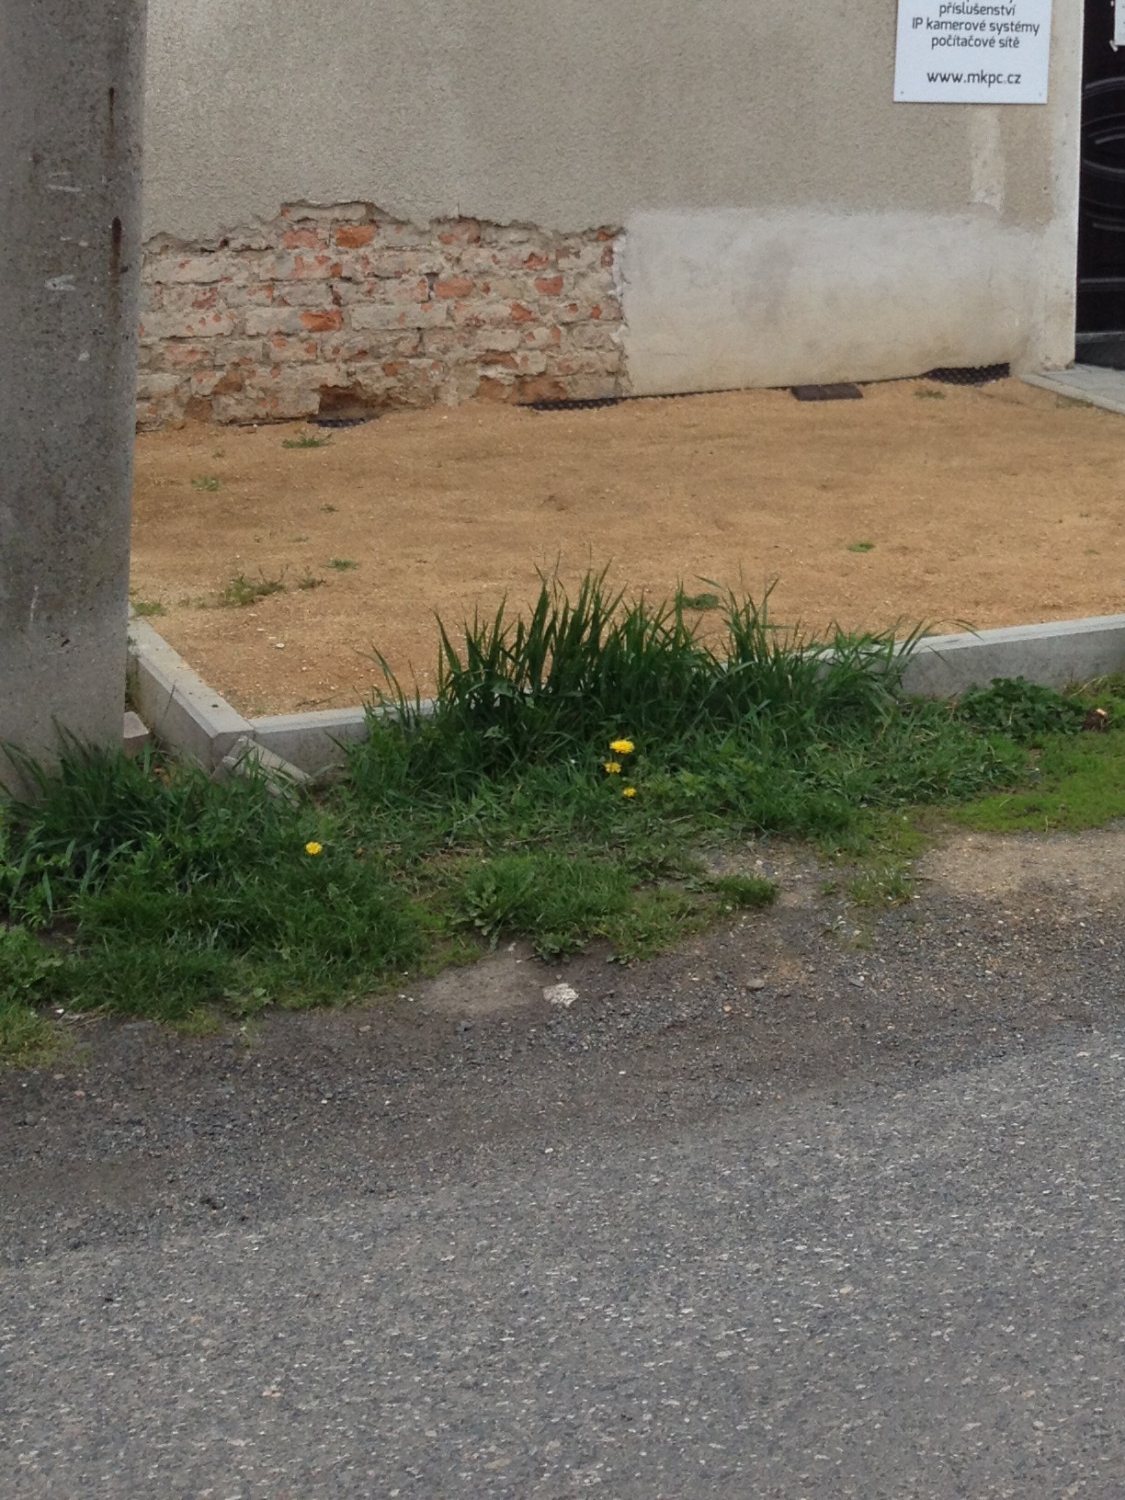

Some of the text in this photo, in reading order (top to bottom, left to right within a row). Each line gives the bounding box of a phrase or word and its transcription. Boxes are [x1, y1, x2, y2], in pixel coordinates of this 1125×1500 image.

[939, 2, 1016, 17] příslušenství
[912, 17, 1040, 36] IP kamerové systémy
[931, 35, 1020, 50] počítačové sítě
[926, 69, 1022, 88] www.mkpc.cz
